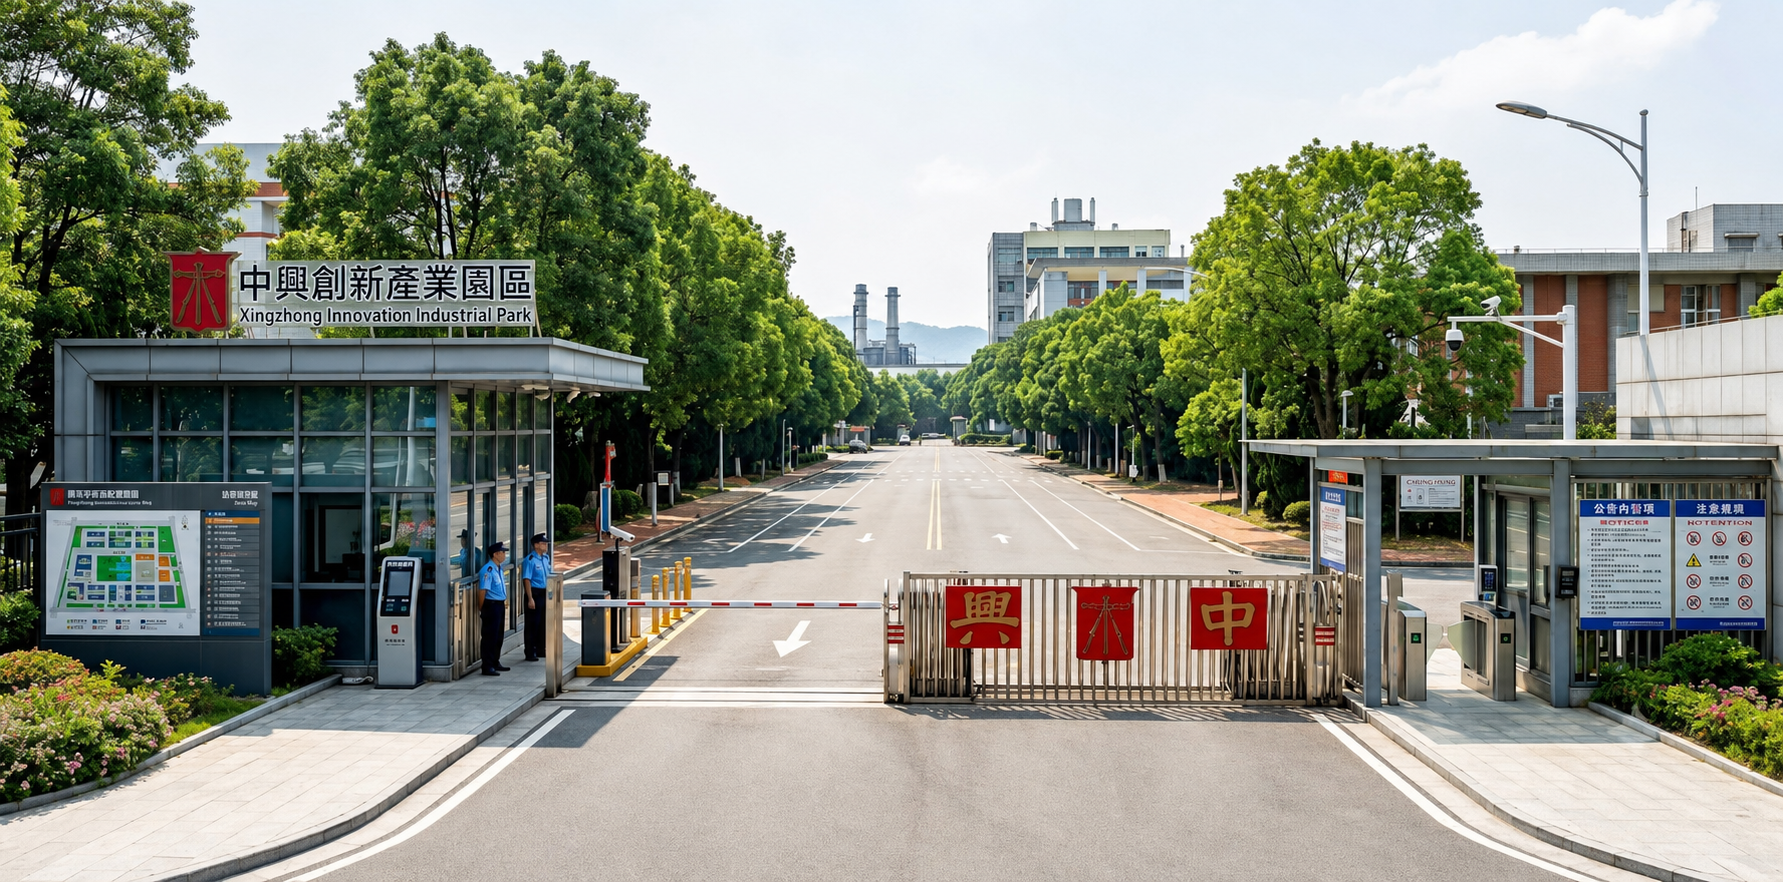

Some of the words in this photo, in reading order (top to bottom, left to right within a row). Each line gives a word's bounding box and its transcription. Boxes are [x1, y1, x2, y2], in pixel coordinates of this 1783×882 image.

[240, 264, 532, 302] 中興創新產業園區
[240, 307, 322, 326] Xingzhong
[327, 307, 411, 323] Innovation
[416, 307, 492, 323] Industrial
[497, 307, 532, 323] Park
[949, 590, 1020, 645] 興
[1200, 591, 1256, 646] 中
